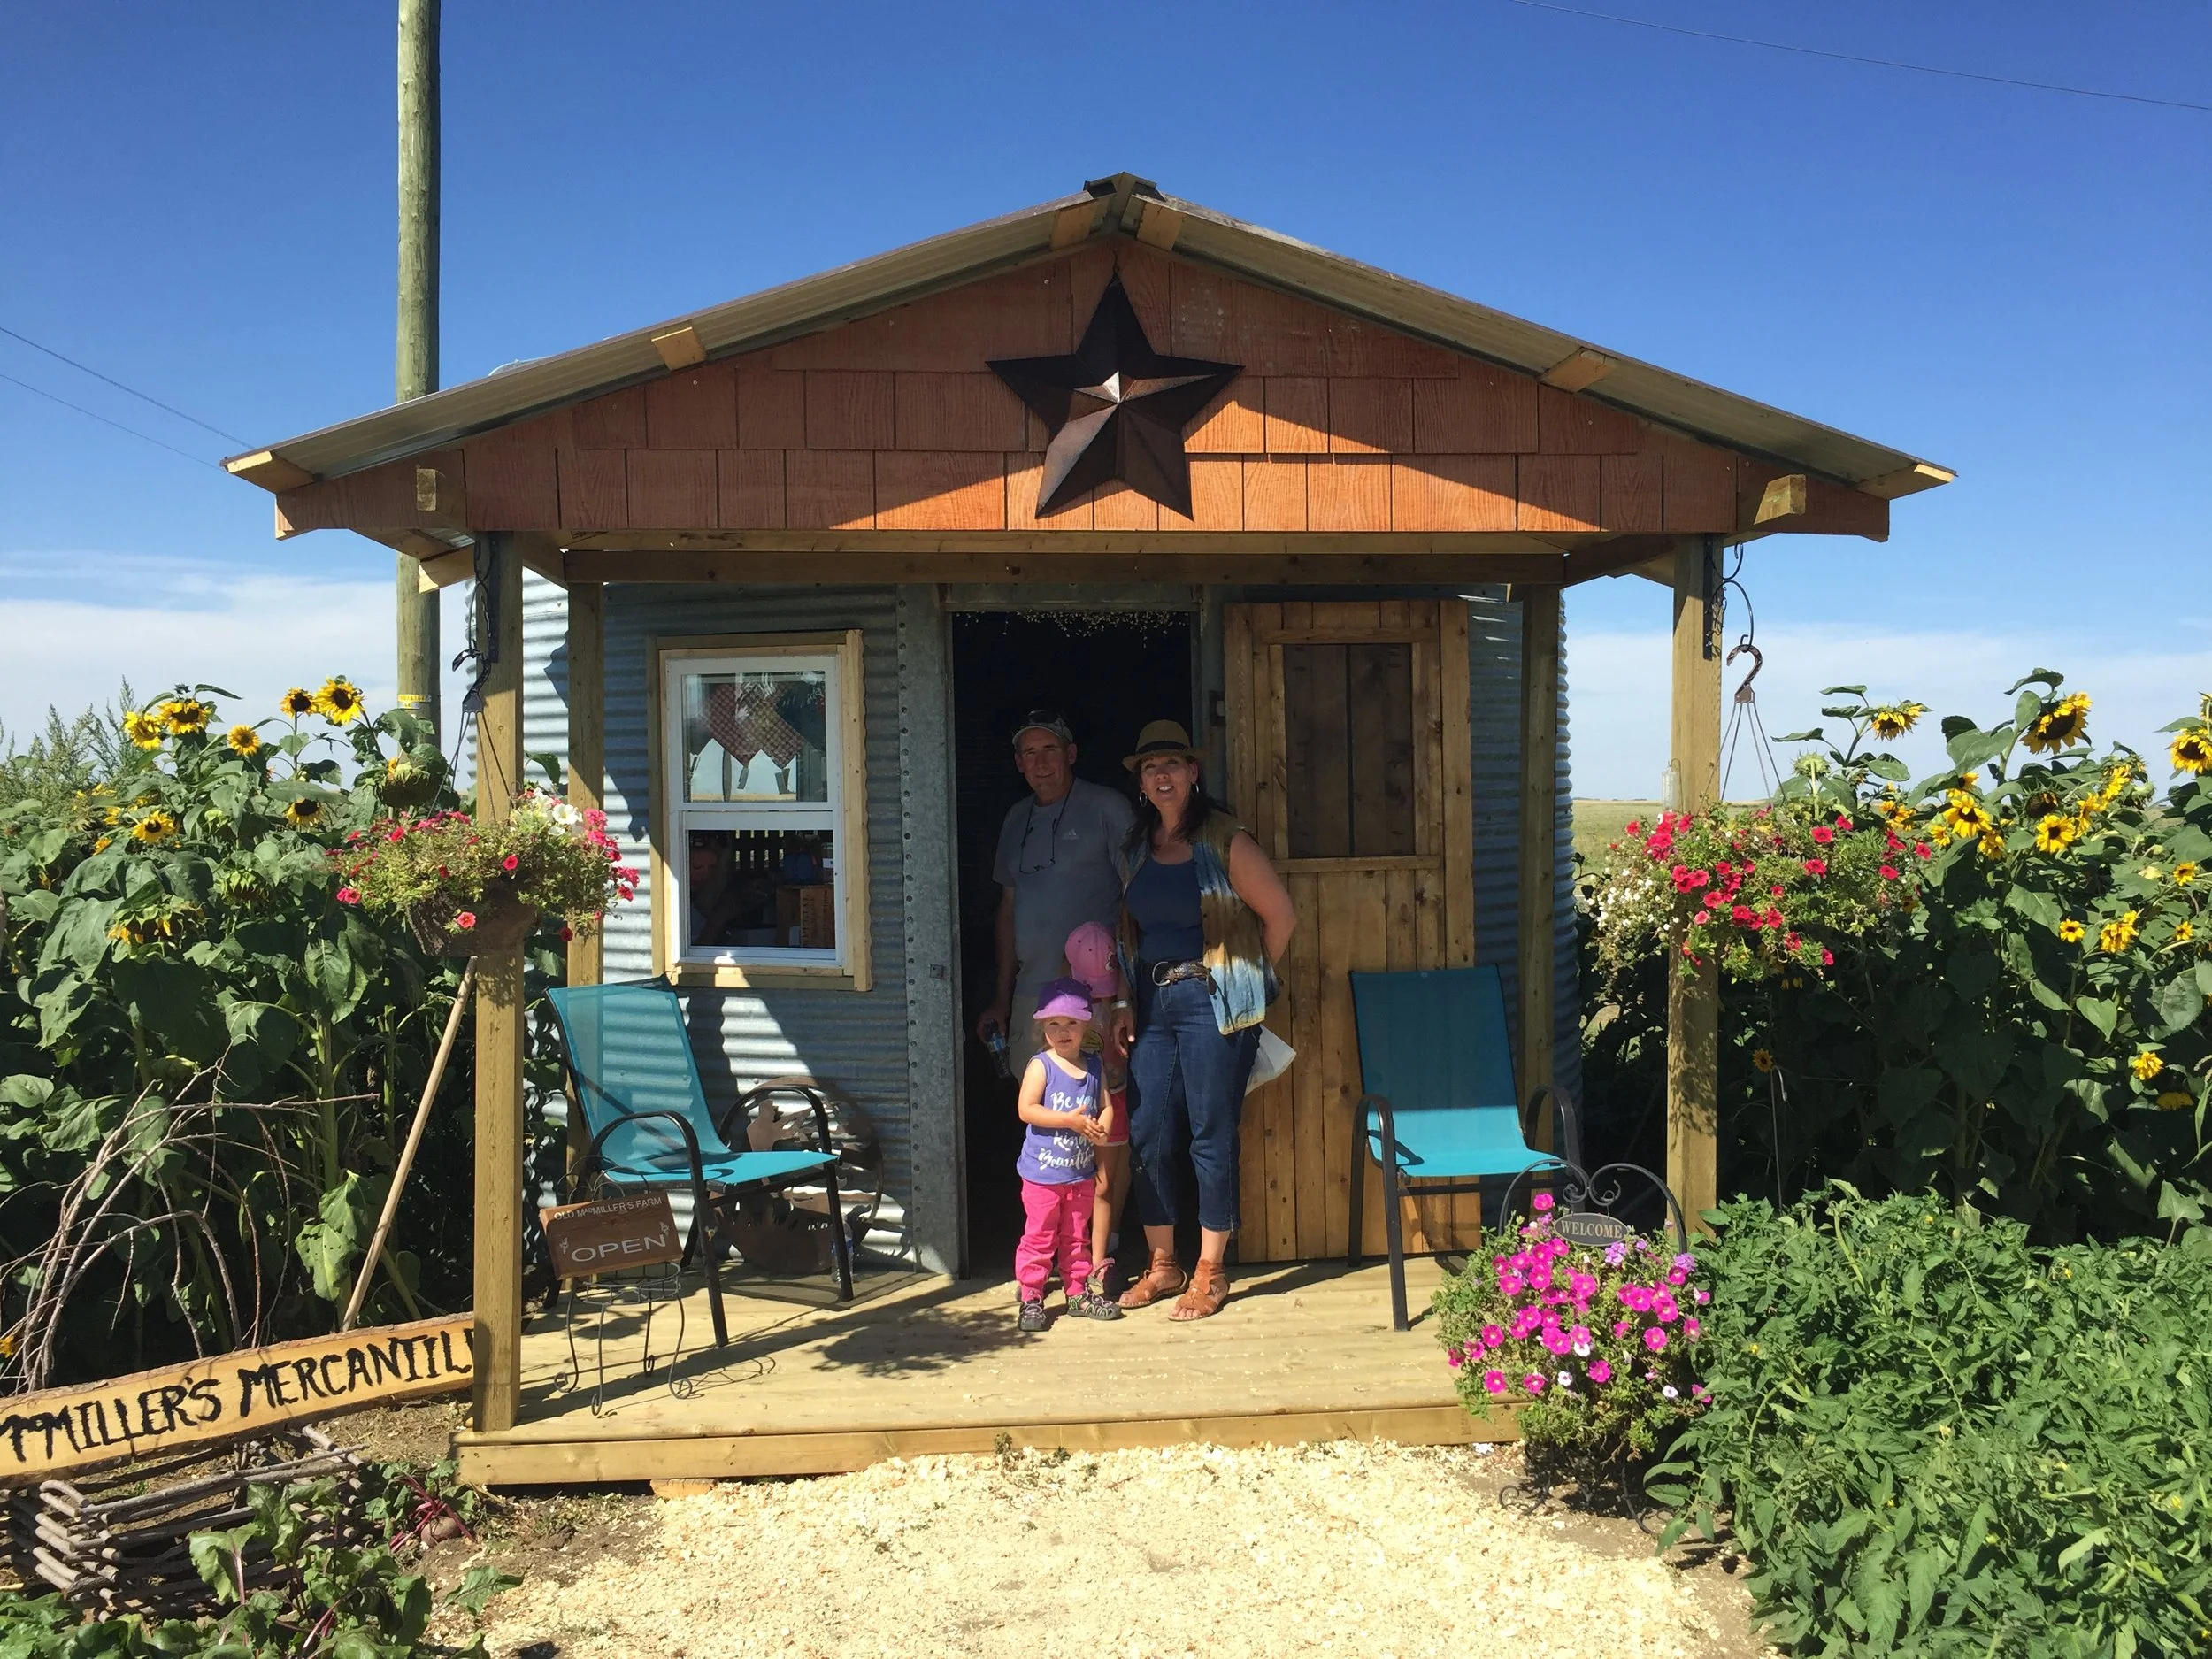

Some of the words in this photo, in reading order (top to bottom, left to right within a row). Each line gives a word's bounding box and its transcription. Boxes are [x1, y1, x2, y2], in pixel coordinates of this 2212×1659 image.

[1050, 1091, 1073, 1112] Be
[553, 1211, 574, 1220] OLD
[635, 1197, 663, 1209] FARM
[1560, 1220, 1623, 1239] WELCOME
[571, 1233, 666, 1262] OPEN
